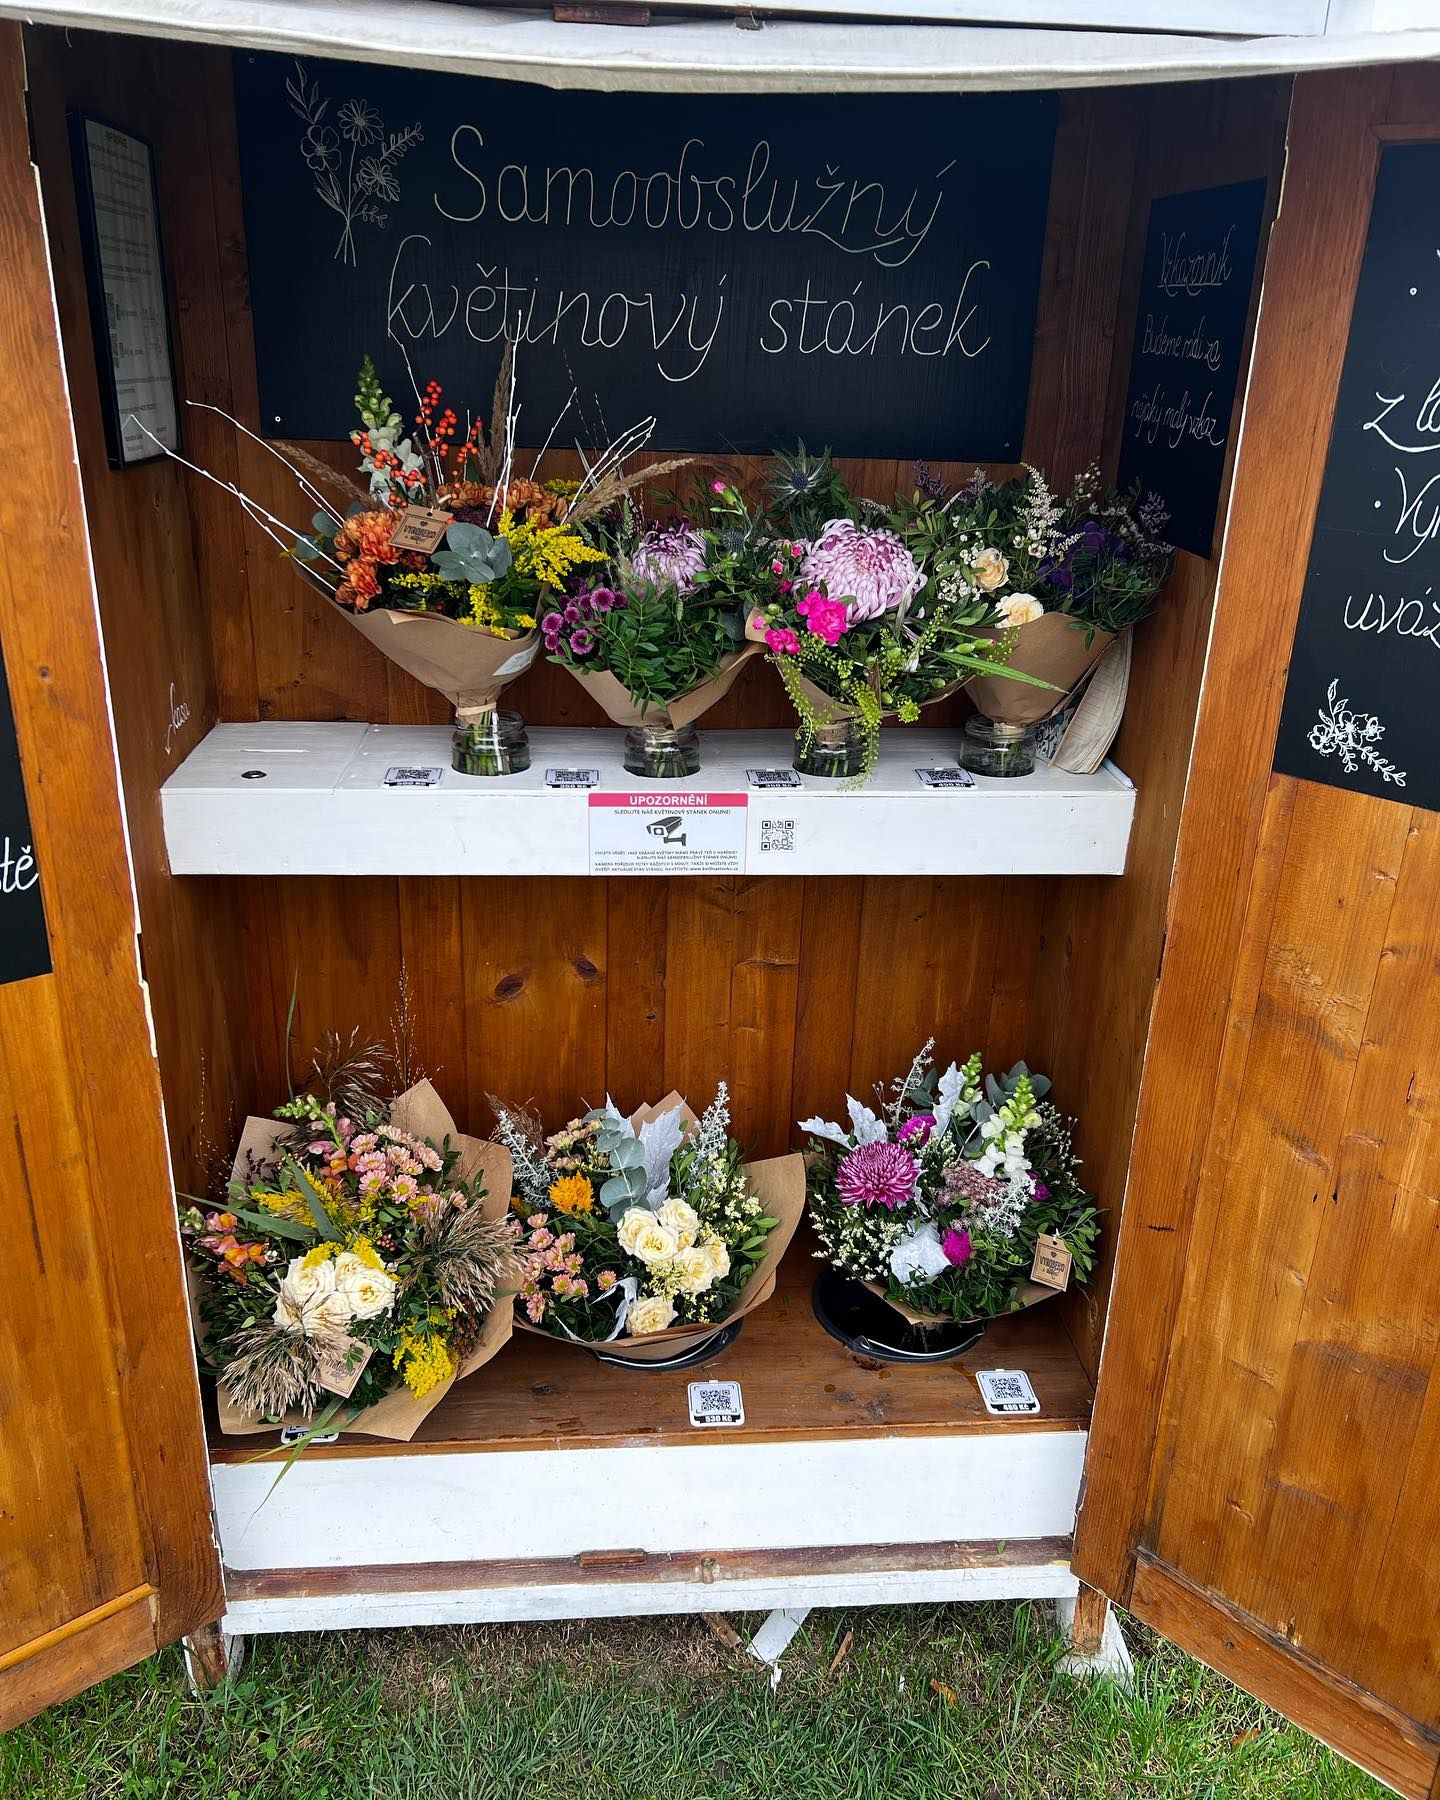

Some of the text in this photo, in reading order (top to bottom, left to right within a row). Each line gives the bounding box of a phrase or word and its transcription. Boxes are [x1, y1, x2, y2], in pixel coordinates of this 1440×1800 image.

[433, 124, 958, 267] Samoobslužný
[386, 235, 991, 382] květinový stánek
[1142, 313, 1221, 371] Budeme rádi za
[1131, 384, 1225, 448] nějaký malý vzkaz
[1384, 466, 1440, 563] Vy
[629, 793, 708, 806] UPOZORNĚNÍ
